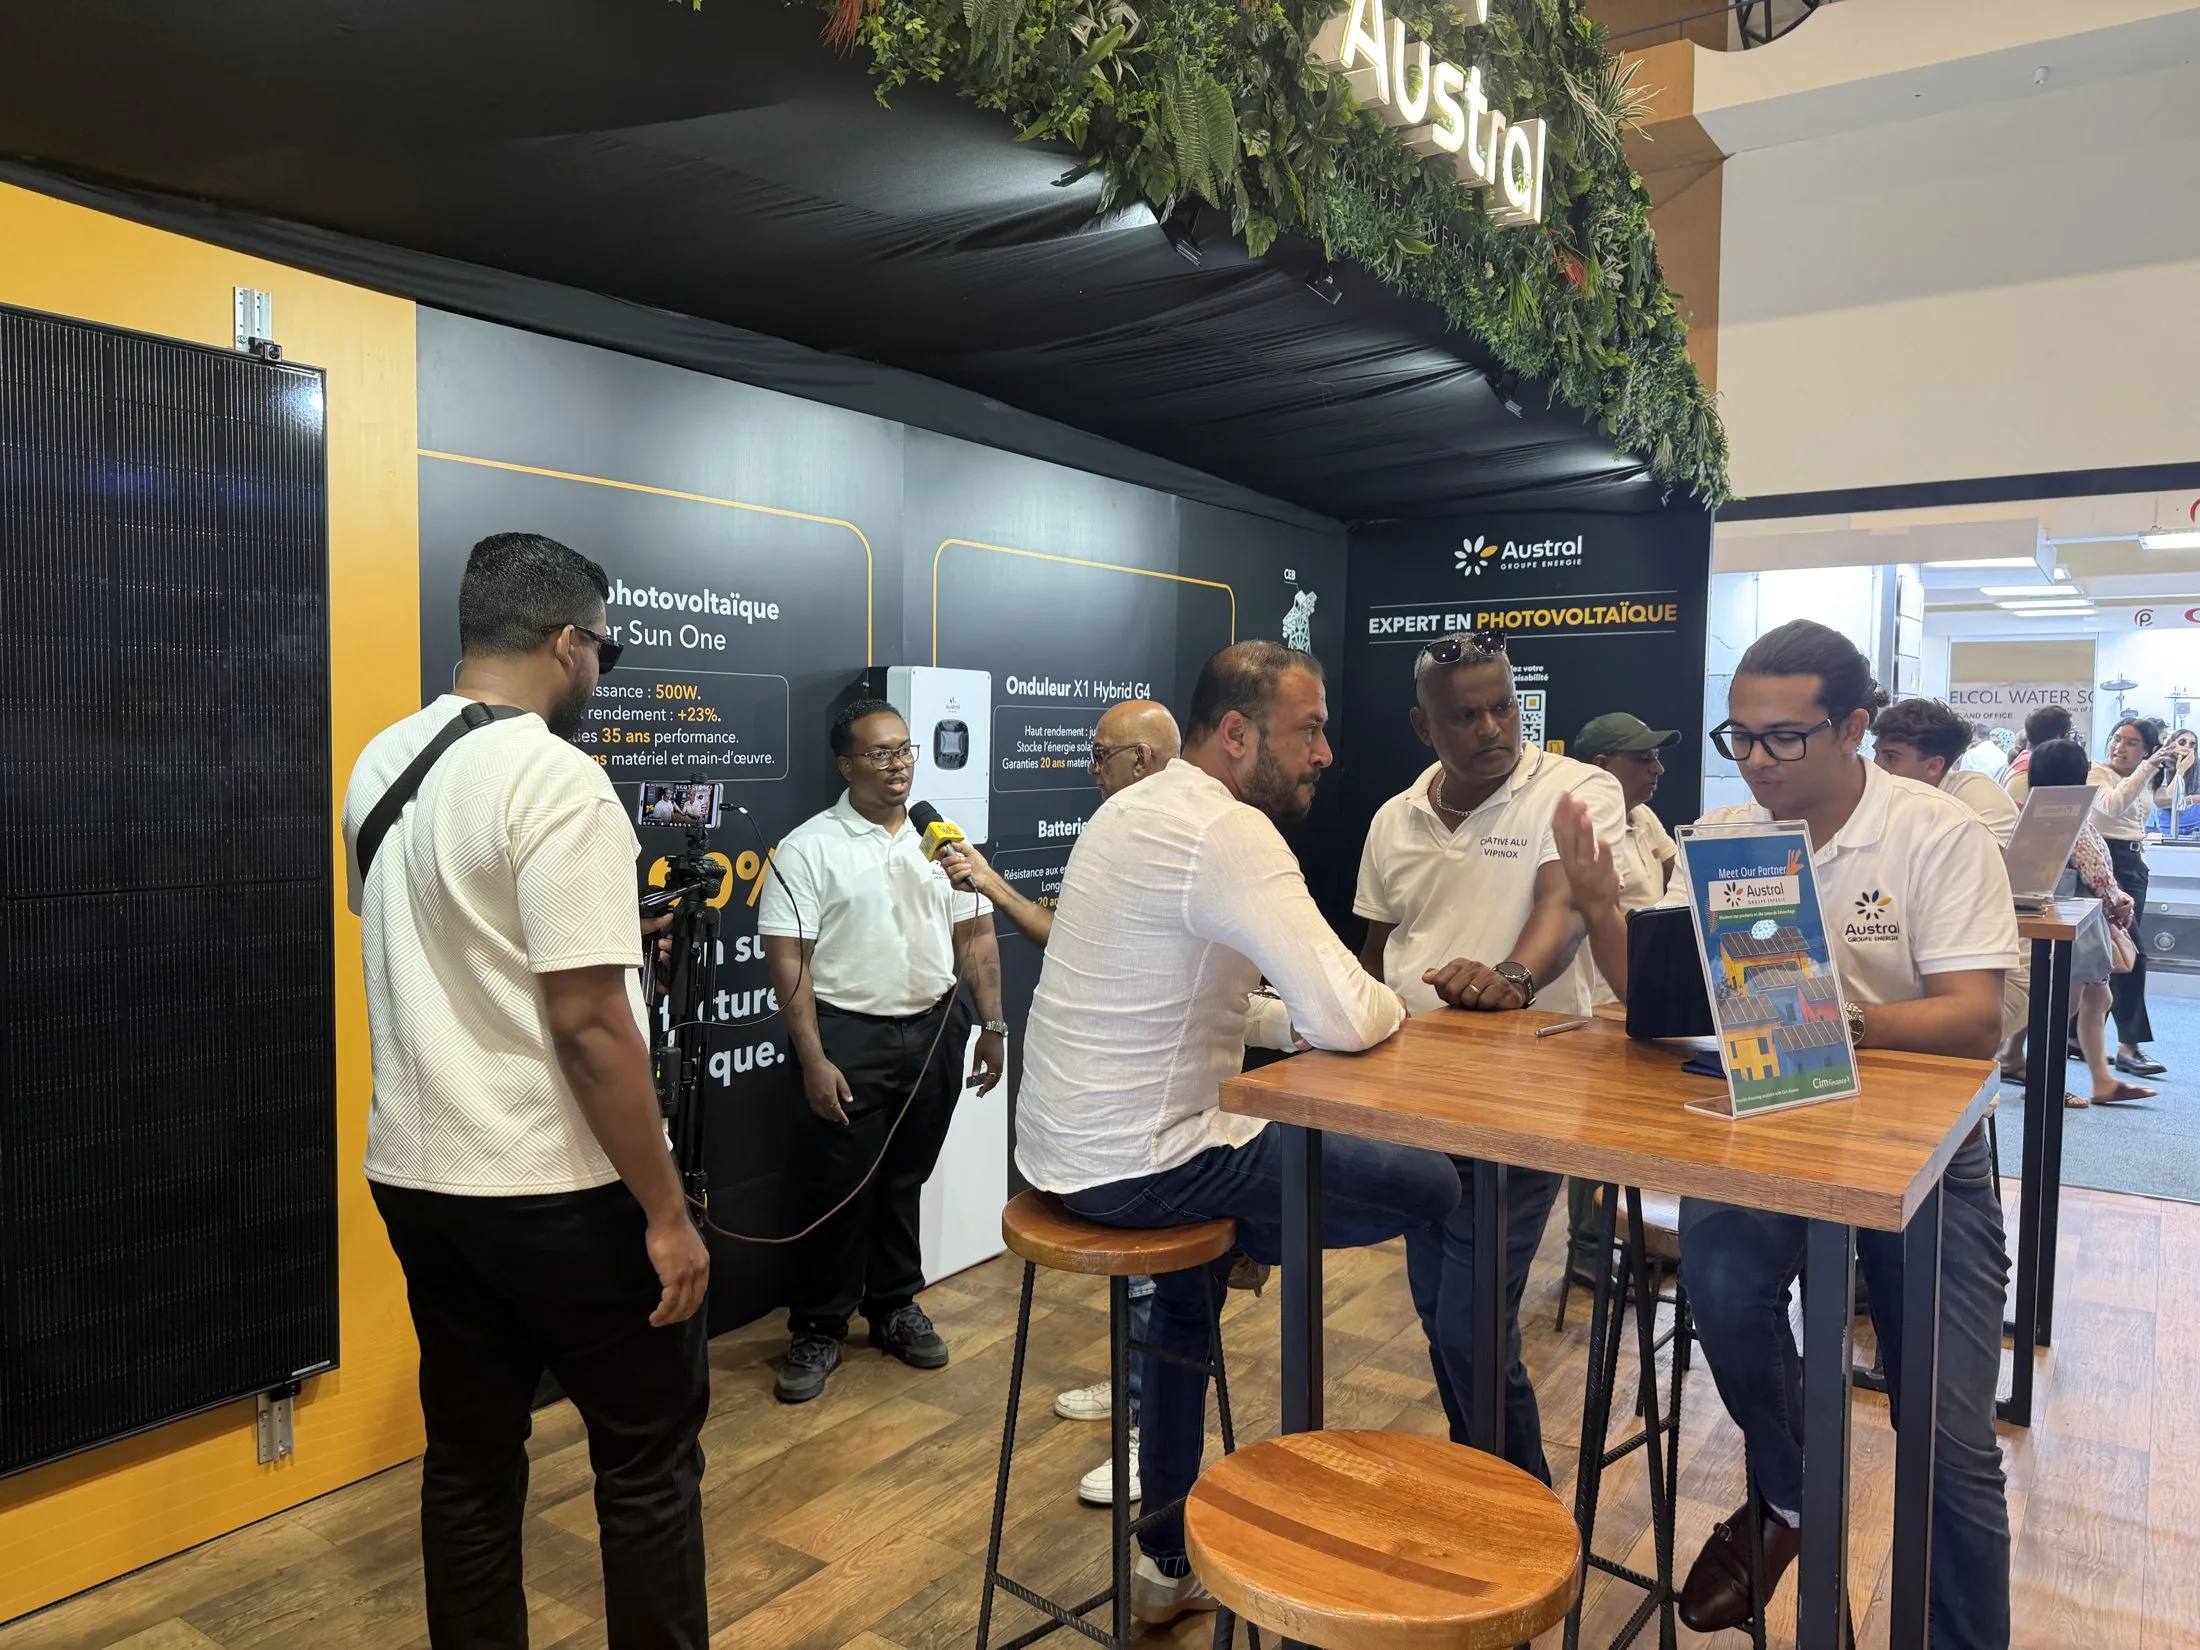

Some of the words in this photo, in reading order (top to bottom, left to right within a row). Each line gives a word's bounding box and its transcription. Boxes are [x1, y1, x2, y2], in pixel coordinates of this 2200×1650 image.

[1340, 0, 1546, 223] Austral
[1501, 535, 1583, 560] Austral
[1500, 561, 1537, 570] GROUPE
[1541, 558, 1582, 568] ENERGIE
[1284, 568, 1296, 581] CEB
[1368, 614, 1441, 634] EXPERT
[1444, 612, 1472, 631] EN
[1476, 601, 1678, 629] PHOTOVOLTAÏQUE
[629, 619, 672, 646] Sun
[679, 624, 727, 650] One
[1523, 664, 1545, 672] votre
[656, 684, 701, 700] 500W.
[1006, 675, 1072, 698] Onduleur
[1073, 680, 1090, 698] X1
[1093, 679, 1133, 703] Hybrid
[1134, 683, 1151, 700] G4
[2008, 689, 2071, 704] WATER
[588, 704, 667, 721] rendement
[678, 706, 722, 722] +23%.
[1983, 712, 2013, 720] OFFICE
[602, 727, 622, 743] 35
[626, 731, 651, 743] ans
[654, 727, 739, 747] performance.
[1024, 725, 1043, 737] Haut
[1044, 725, 1084, 737] rendement
[1016, 741, 1042, 752] Stocke
[1043, 740, 1076, 755] l'énergie
[611, 749, 667, 766] matériel
[671, 753, 685, 765] et
[1002, 757, 1039, 770] Garanties
[1040, 756, 1051, 769] 20
[1052, 759, 1066, 769] ans
[1510, 838, 1528, 847] ALU
[1484, 848, 1519, 859] VIPINOX
[1004, 867, 1044, 880] Résistance
[1045, 868, 1059, 877] aux
[1718, 867, 1739, 879] Meet
[1740, 866, 1757, 877] Our
[1757, 865, 1787, 876] Partner
[1746, 881, 1785, 898] Austral
[1037, 896, 1049, 908] 20
[1844, 920, 1900, 936] Austral
[1847, 935, 1873, 943] GROUPE
[1812, 1077, 1829, 1089] Cim
